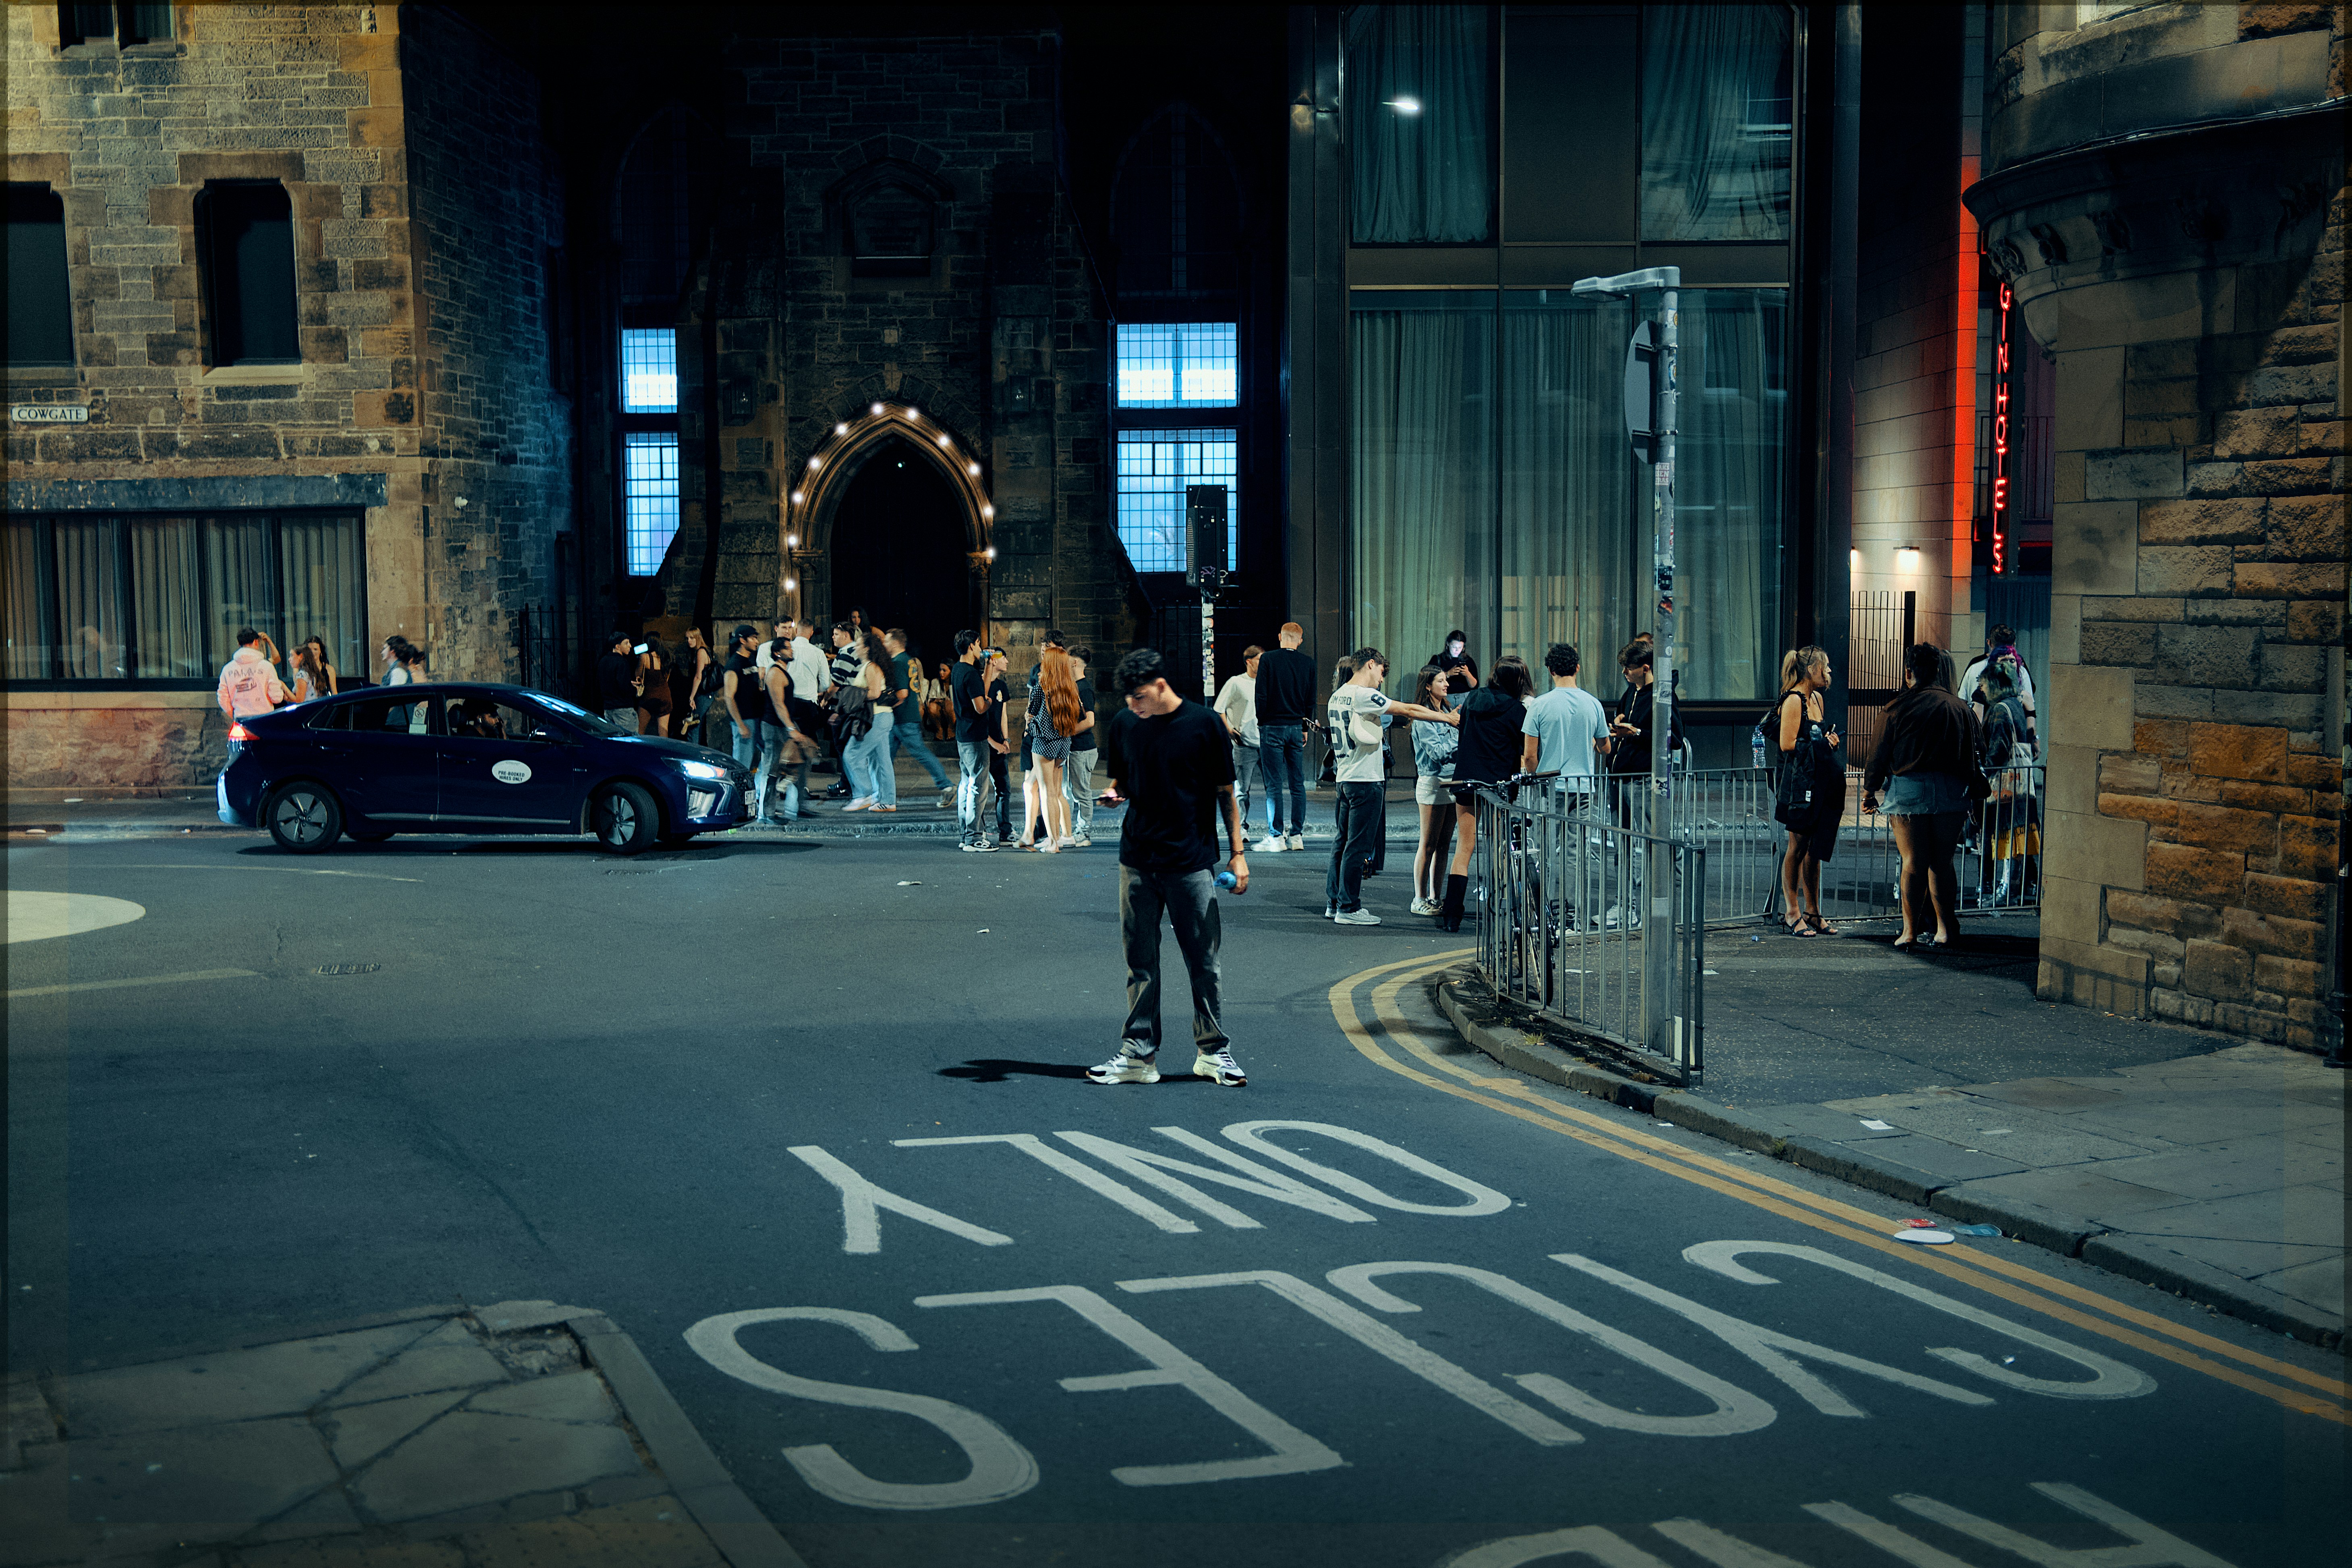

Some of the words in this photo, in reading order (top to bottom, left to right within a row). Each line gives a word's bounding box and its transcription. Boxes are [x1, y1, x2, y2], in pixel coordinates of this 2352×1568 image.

[18, 409, 83, 420] COWGATE
[1992, 383, 2008, 574] HOTELS
[1338, 696, 1352, 705] FORD
[1371, 694, 1386, 707] 6
[787, 1120, 1513, 1255] ONLY
[682, 1239, 2158, 1510] CYCLES
